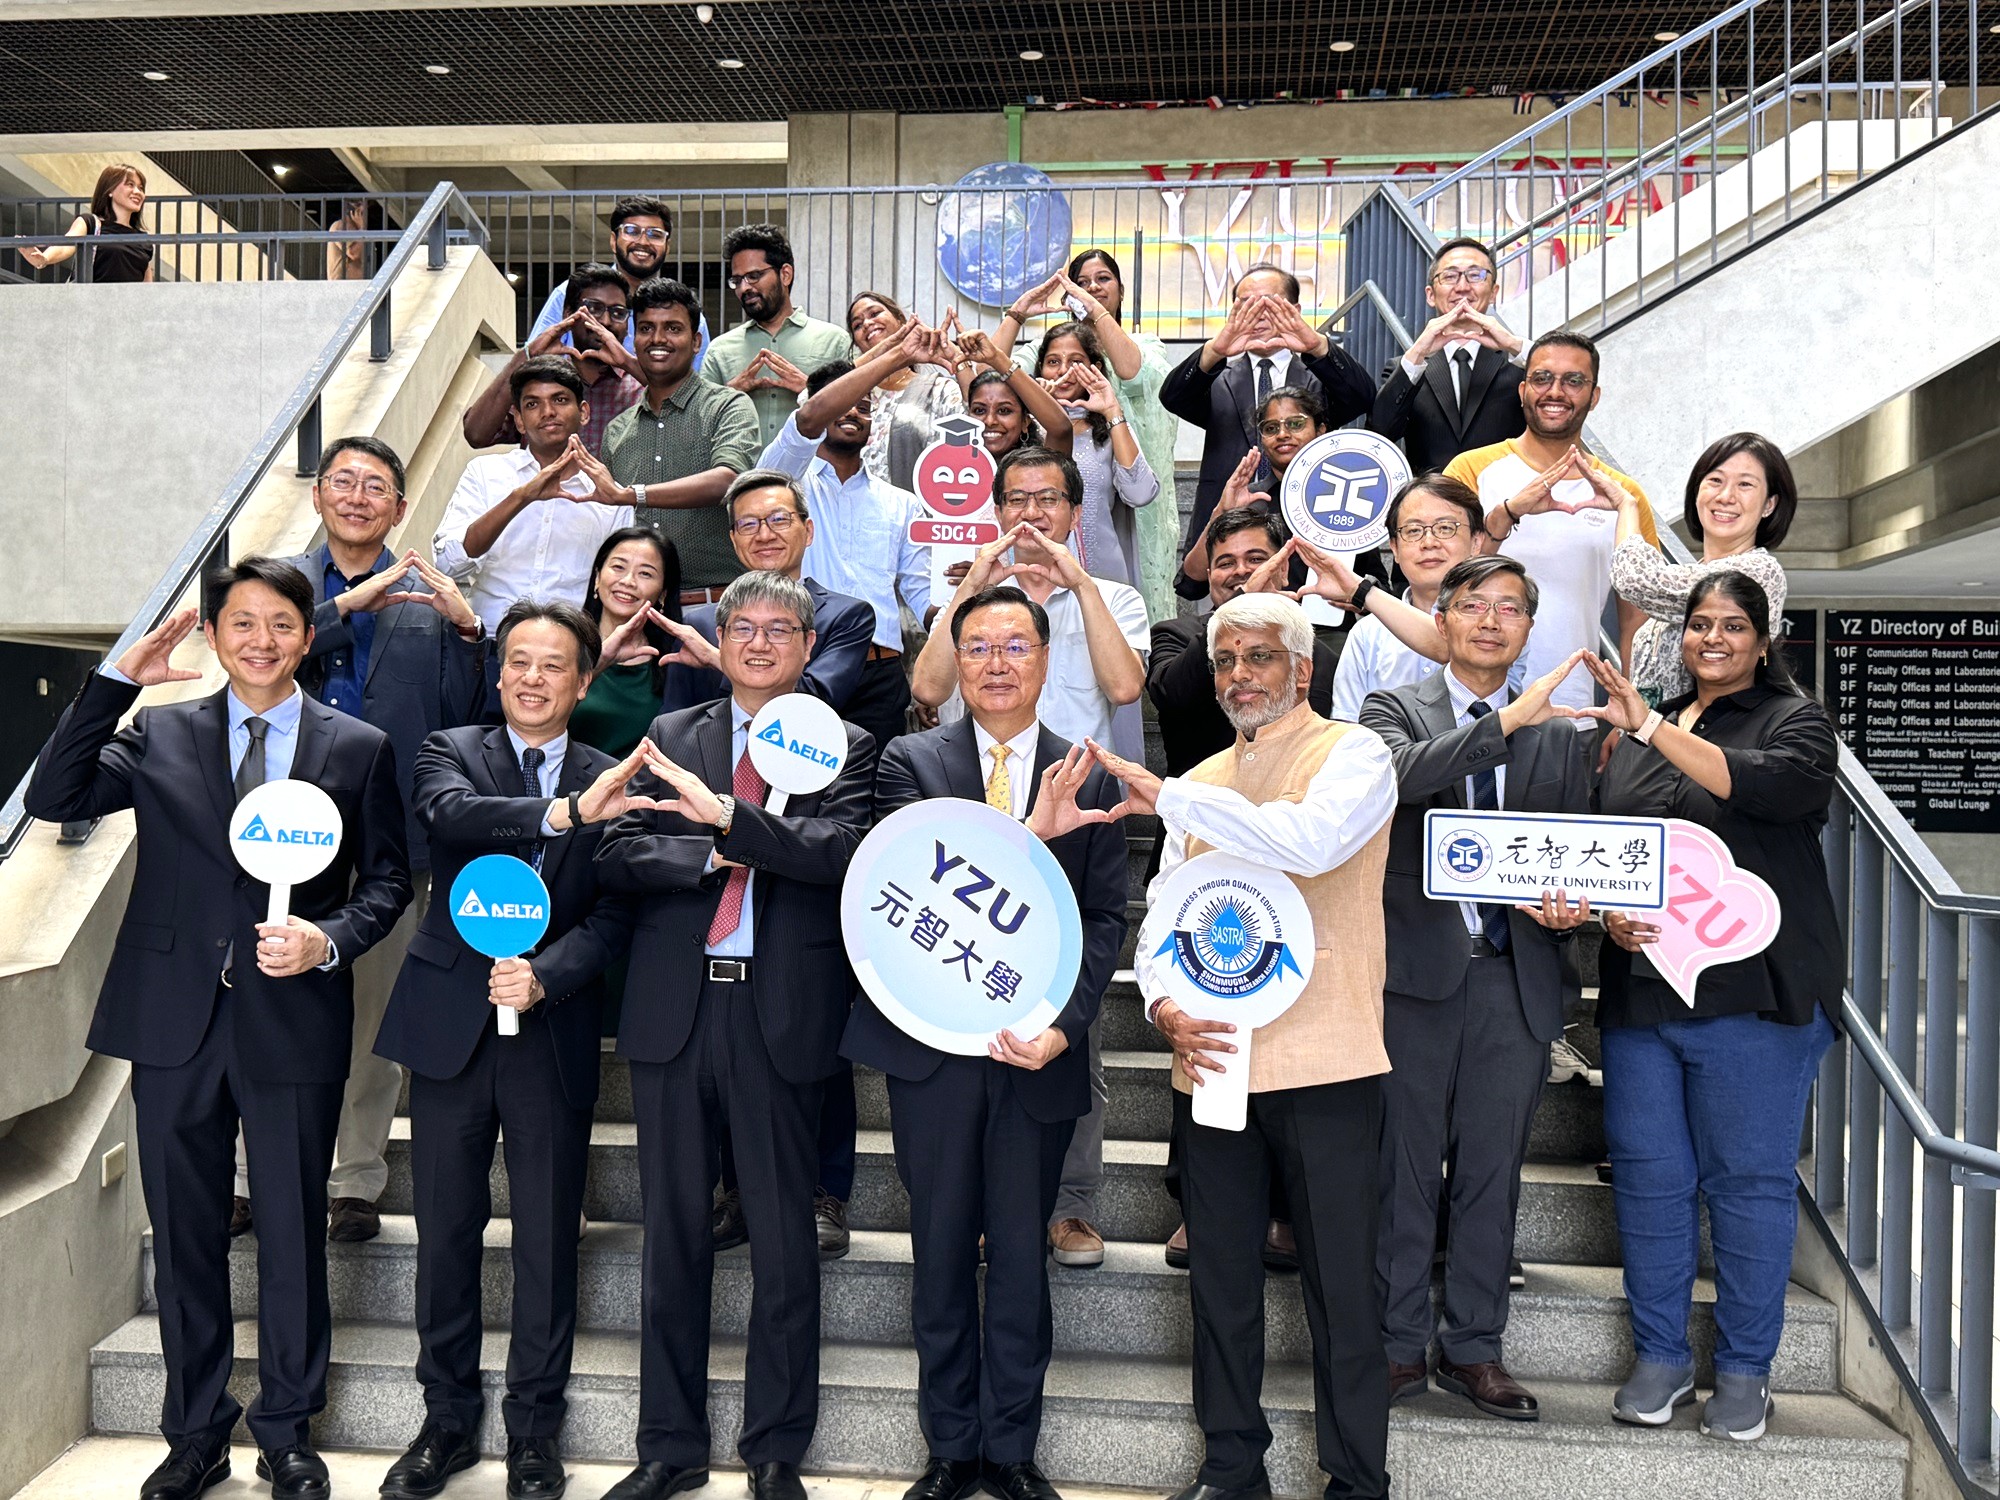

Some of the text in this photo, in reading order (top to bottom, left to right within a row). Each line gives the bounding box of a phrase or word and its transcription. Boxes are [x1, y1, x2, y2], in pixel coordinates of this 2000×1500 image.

[1141, 158, 1342, 241] YZU
[1292, 506, 1386, 547] YUAN ZE UNIVERSIT
[1328, 514, 1355, 526] 1989
[931, 524, 977, 542] SDG 4
[1840, 618, 2000, 639] YZ Directory of Bui
[1866, 648, 1928, 658] Communication
[1932, 648, 1969, 659] Research
[1972, 649, 1999, 659] Center
[1867, 665, 1897, 677] Faculty
[1901, 665, 1930, 675] Offices
[1935, 666, 1950, 675] and
[1867, 682, 1897, 694] Faculty
[1901, 682, 1930, 692] Offices
[1935, 683, 1950, 692] and
[1867, 698, 1897, 710] Faculty
[1901, 699, 1930, 709] Offices
[1935, 699, 1950, 709] and
[1867, 715, 1897, 727] Faculty
[1901, 716, 1930, 726] Offices
[1935, 716, 1950, 726] and
[1866, 729, 1894, 737] College
[789, 739, 839, 770] DELTA
[1867, 747, 1919, 758] Laboratories
[1928, 748, 1967, 759] Teachers'
[1971, 749, 2000, 762] Lounge
[1963, 788, 1994, 796] Language
[1929, 798, 1956, 809] Global
[1958, 799, 1990, 812] Lounge
[277, 829, 334, 846] DELTA
[1499, 834, 1651, 874] 元智大學
[929, 839, 1031, 935] YZU
[1497, 873, 1653, 892] YUAN ZE UNIVERSITY
[491, 903, 543, 920] DELTA
[1175, 879, 1283, 939] PROGRESS THROUGH QUALITY EDUCATION
[1666, 863, 1748, 949] ZU
[871, 881, 1023, 1003] 元智大學
[1211, 925, 1245, 945] SASTRA
[1197, 975, 1233, 994] TECHNOLOGY
[1233, 986, 1240, 994] &
[1239, 973, 1267, 993] RESEARCH
[1263, 948, 1281, 977] ACADEMY
[1200, 970, 1250, 987] SHANMUGHA
